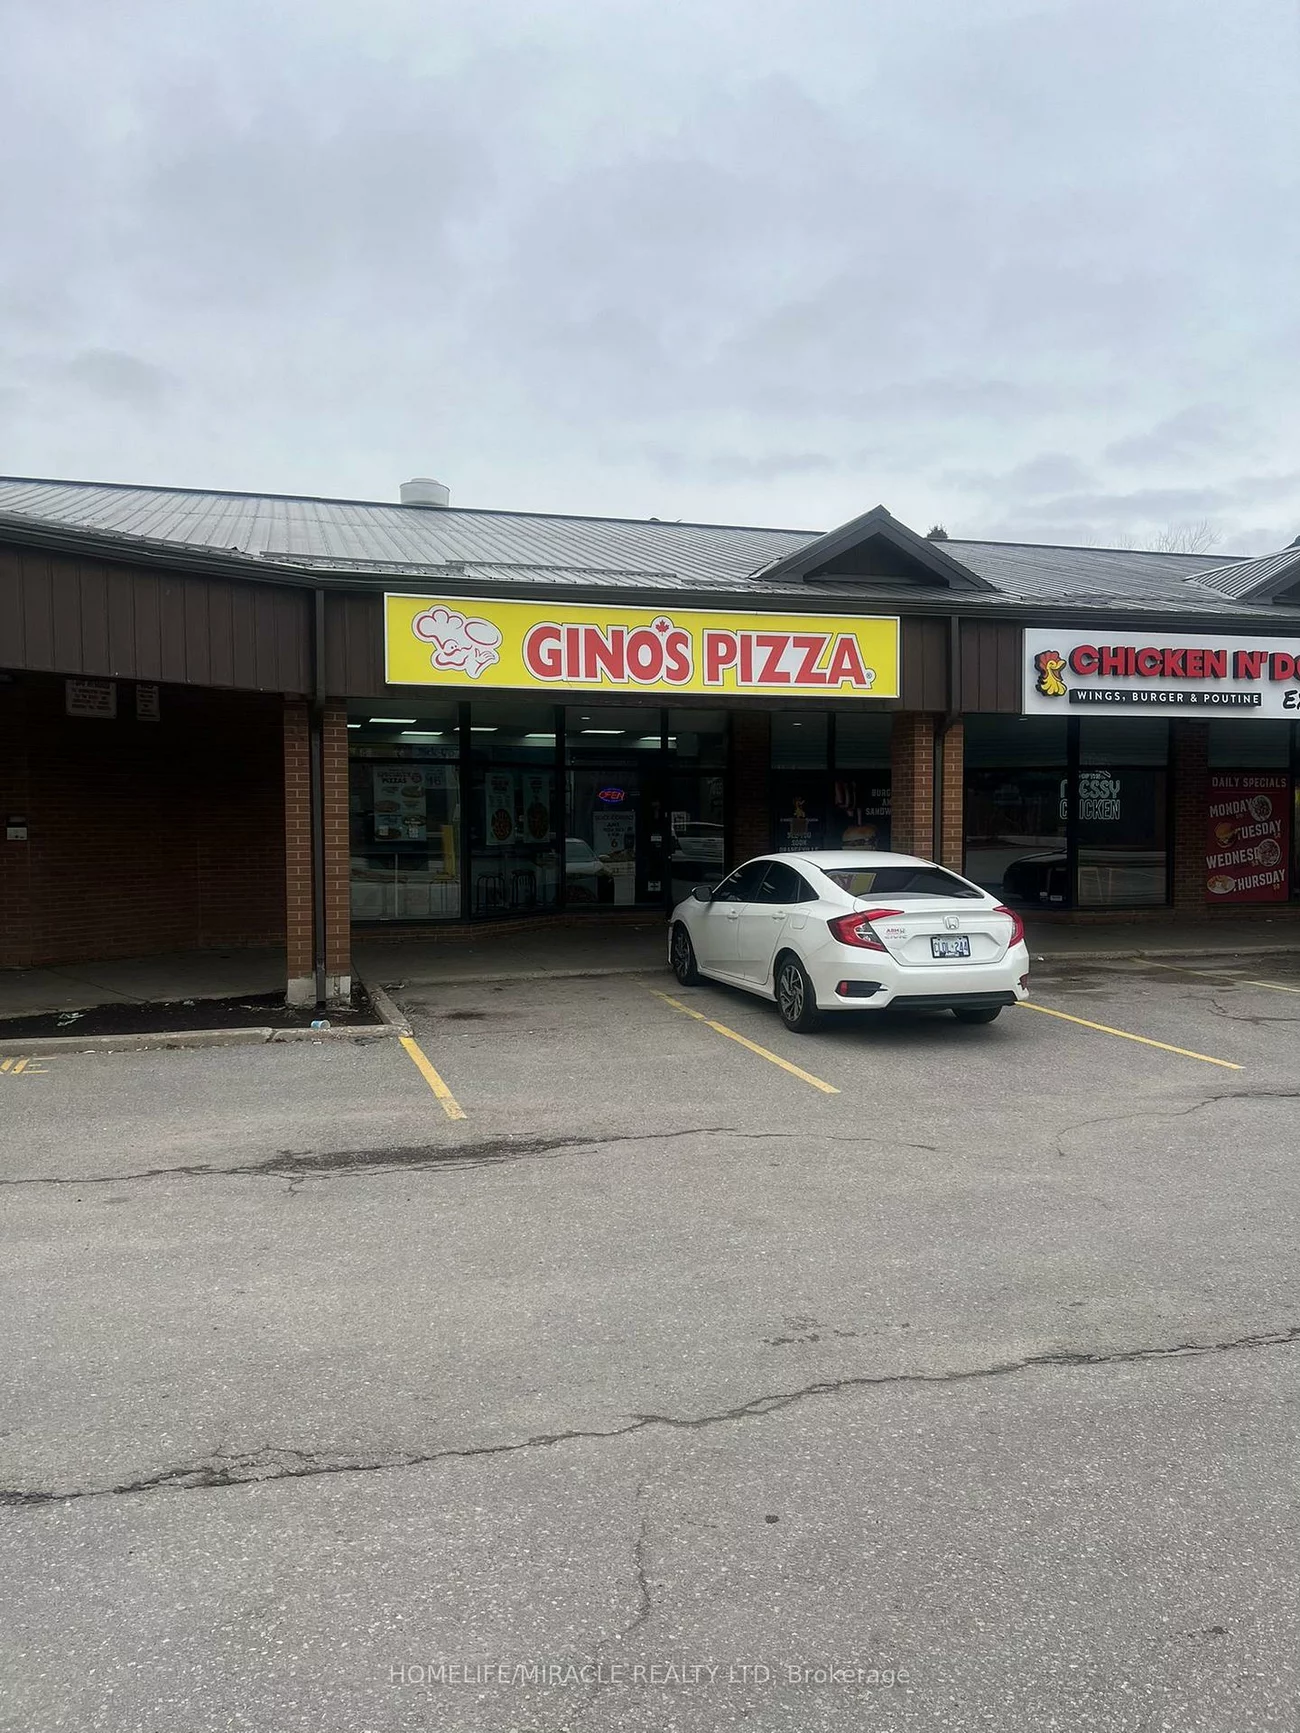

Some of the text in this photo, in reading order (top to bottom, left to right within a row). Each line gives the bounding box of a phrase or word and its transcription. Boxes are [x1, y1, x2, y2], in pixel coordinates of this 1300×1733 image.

[1070, 645, 1228, 678] CHICKEN
[1077, 691, 1260, 704] WINGS, BURGER & POUTINE
[1211, 777, 1287, 787] DAILY SPECIALS
[598, 789, 625, 802] OPEN
[1209, 798, 1253, 818] MONDAY
